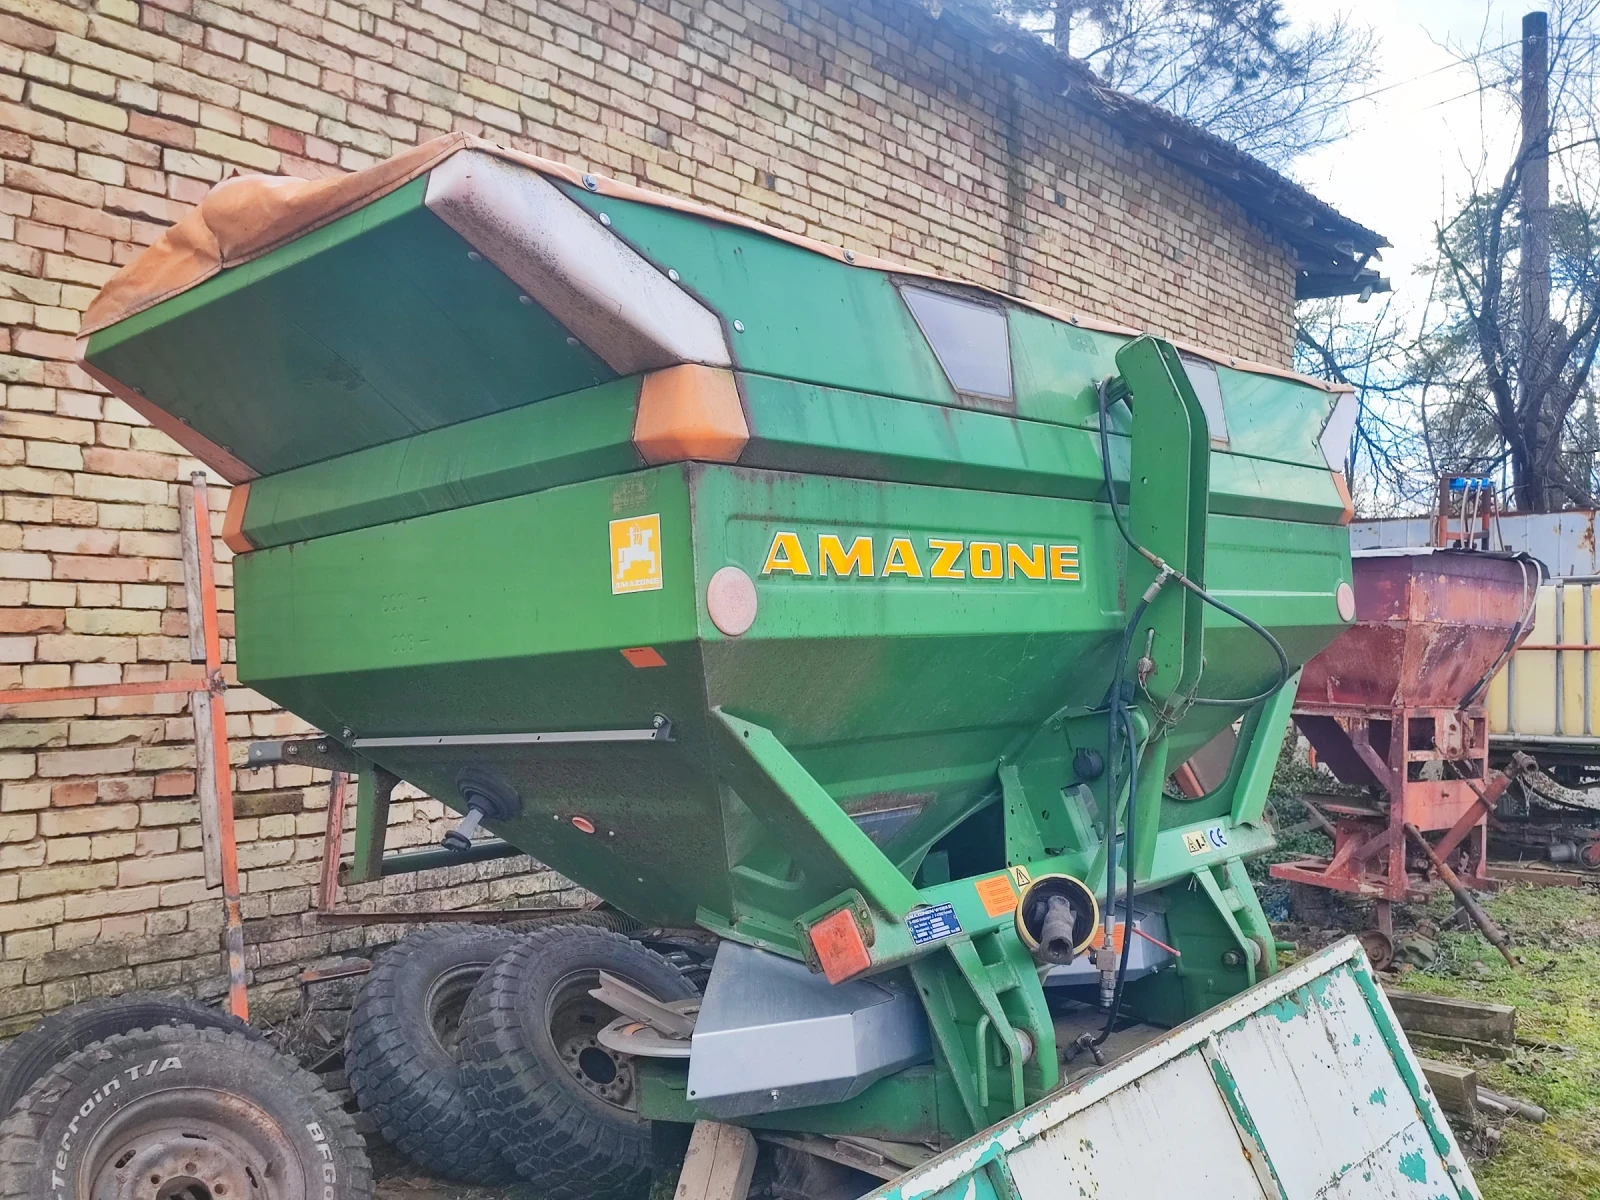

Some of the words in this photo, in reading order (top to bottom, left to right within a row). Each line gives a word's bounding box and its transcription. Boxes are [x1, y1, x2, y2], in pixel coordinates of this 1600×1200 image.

[761, 531, 1080, 580] AMAZONE
[615, 577, 660, 588] AMAZONE
[51, 1075, 121, 1190] Terrain
[124, 1056, 183, 1081] T/A
